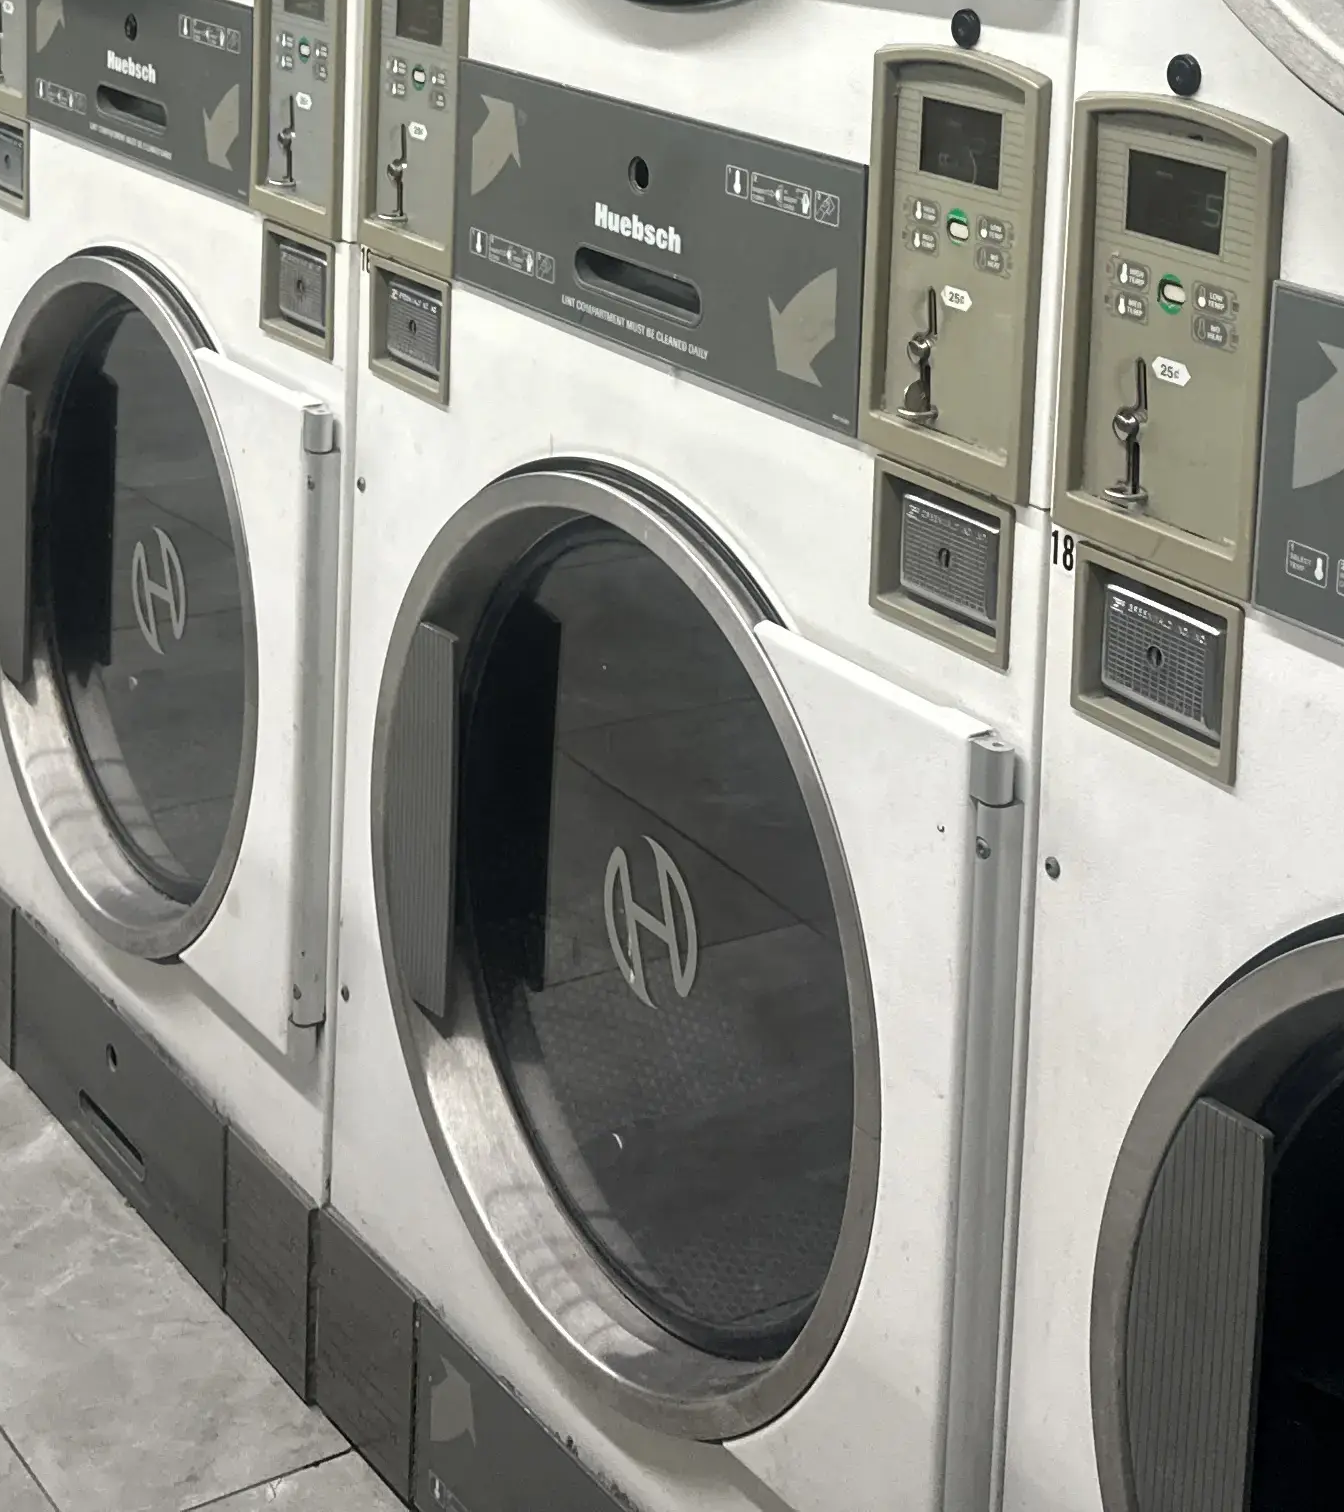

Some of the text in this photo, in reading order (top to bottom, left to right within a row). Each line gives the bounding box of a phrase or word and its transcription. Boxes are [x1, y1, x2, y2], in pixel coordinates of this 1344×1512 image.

[106, 50, 156, 84] Huebsch
[594, 201, 681, 255] Huebsch
[1160, 364, 1180, 379] 25¢
[1051, 530, 1074, 571] 18
